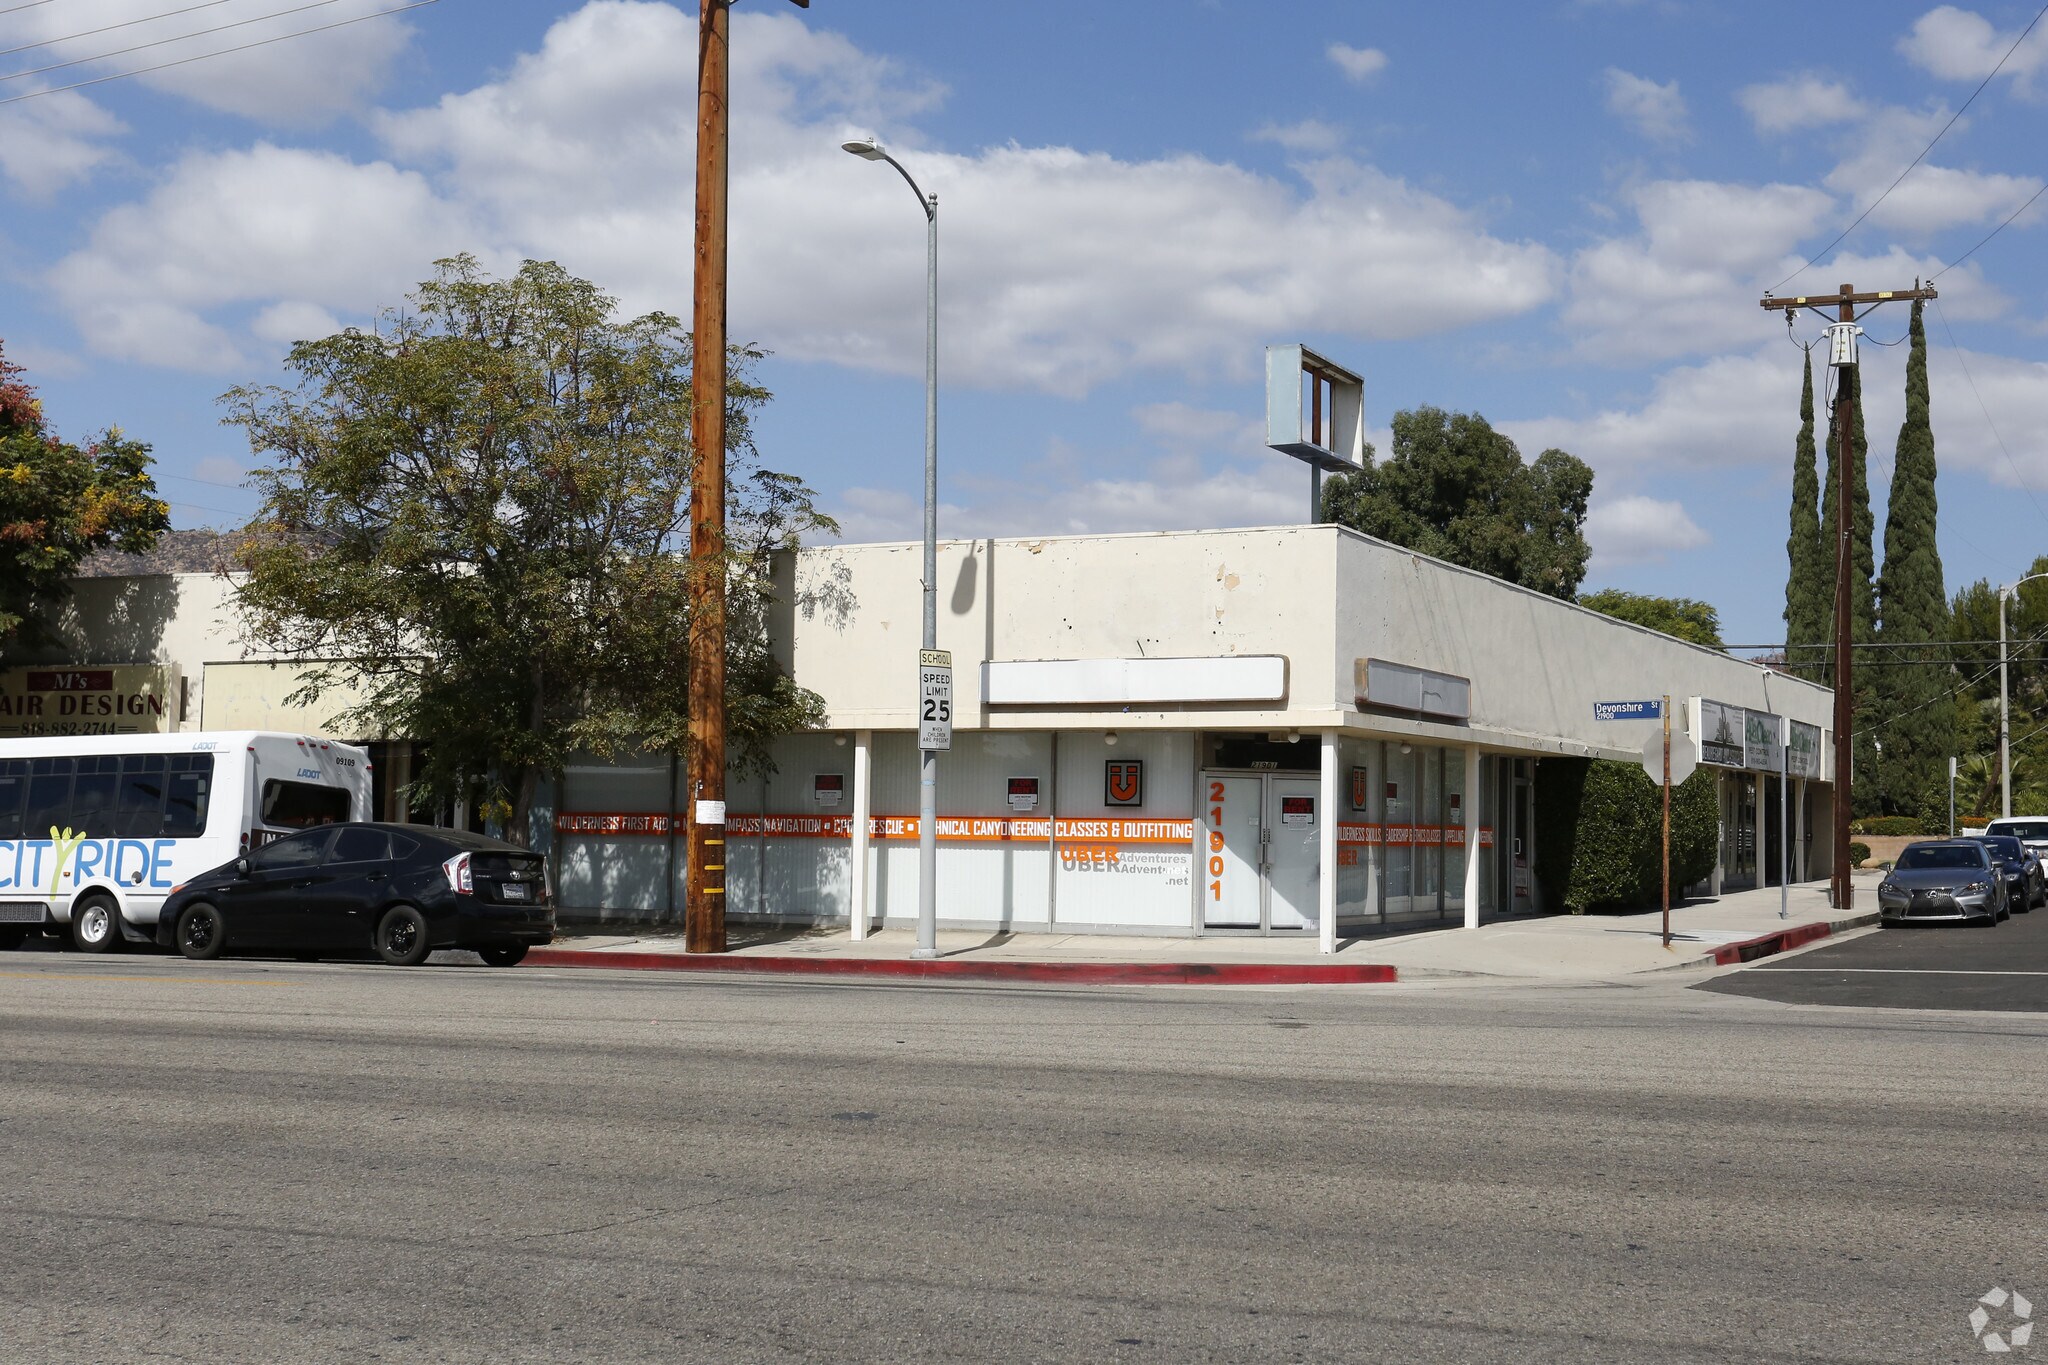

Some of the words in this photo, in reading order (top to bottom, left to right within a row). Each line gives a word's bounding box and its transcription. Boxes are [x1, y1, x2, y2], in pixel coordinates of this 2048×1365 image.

[921, 653, 950, 665] SCHOOL
[53, 673, 88, 689] M's
[923, 673, 950, 684] SPEED
[926, 686, 948, 696] LIMIT
[59, 694, 163, 716] DESIGN
[923, 698, 950, 722] 25
[1596, 703, 1643, 713] Devonshire
[1651, 701, 1658, 709] St
[1596, 712, 1615, 720] 21900
[20, 722, 117, 736] 818-882-2744
[192, 742, 218, 750] LADOT
[336, 757, 355, 767] 09109
[1251, 761, 1277, 769] 21901
[297, 768, 321, 780] LADOT
[559, 816, 619, 830] WILDERNESS
[622, 817, 650, 830] FIRST
[653, 817, 668, 830] AID
[725, 818, 760, 832] MPASS
[764, 819, 821, 833] NAVIGATION
[917, 820, 970, 835] THNICAL
[974, 821, 1051, 836] CANYONEERING
[1056, 822, 1108, 837] CLASSES
[1111, 822, 1120, 837] &
[1124, 823, 1192, 838] OUTFITTING
[1386, 828, 1408, 842] EADERSHIP
[1209, 782, 1225, 902] 21901
[1060, 846, 1120, 862] UBER
[1119, 853, 1187, 864] Adventures
[1165, 877, 1189, 886] .net
